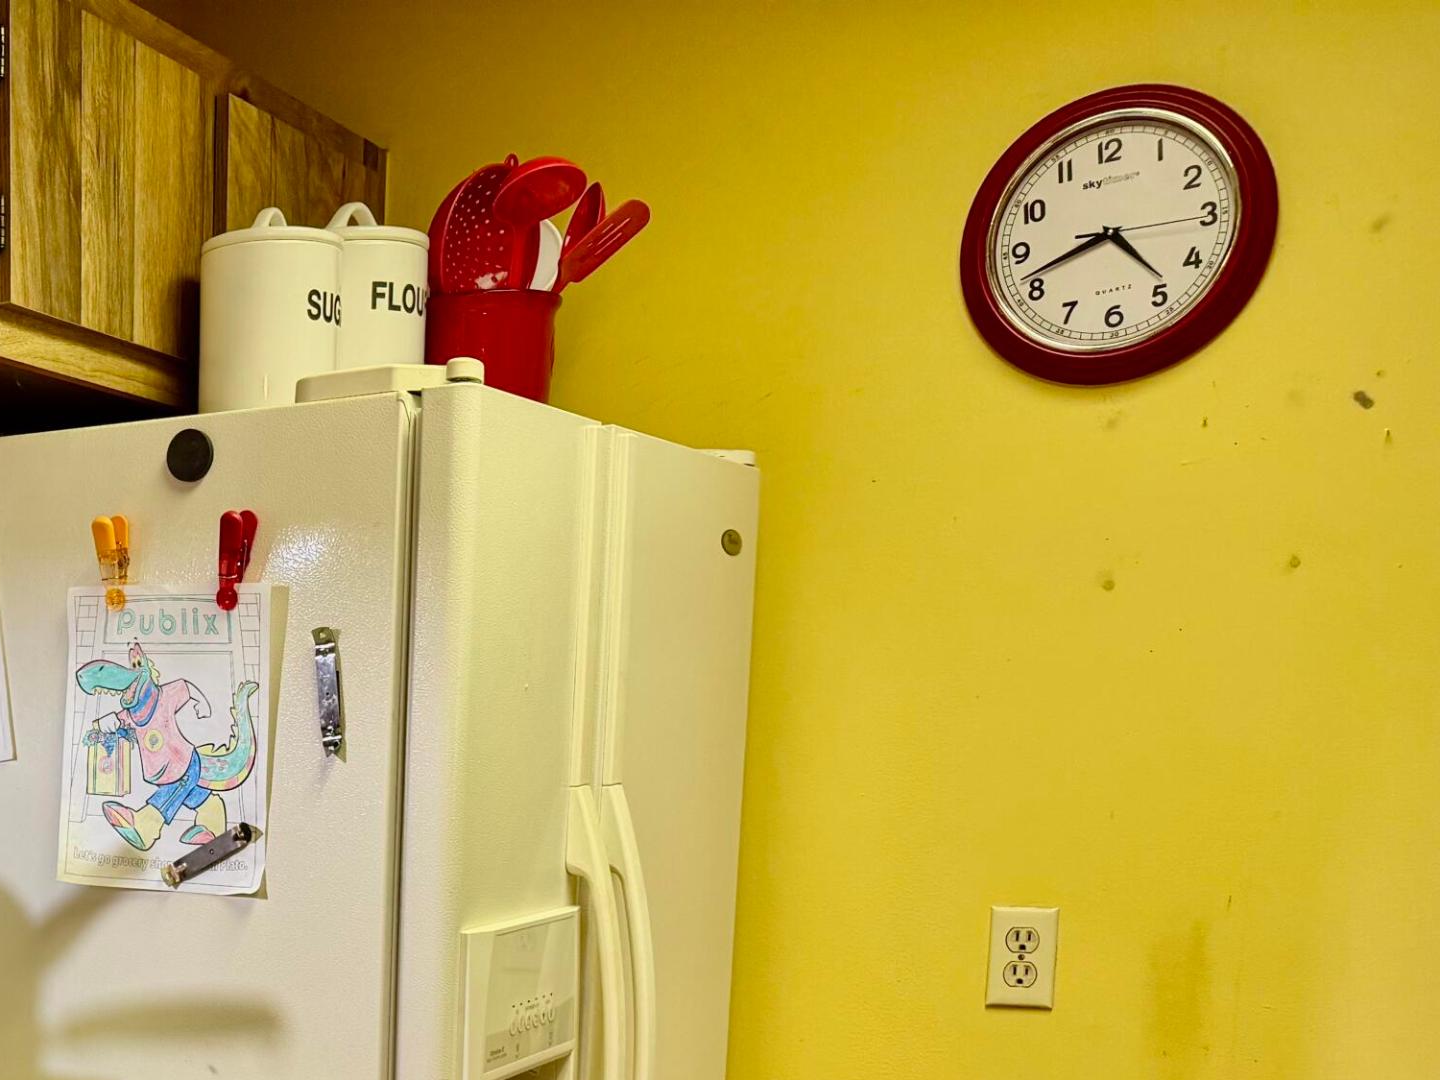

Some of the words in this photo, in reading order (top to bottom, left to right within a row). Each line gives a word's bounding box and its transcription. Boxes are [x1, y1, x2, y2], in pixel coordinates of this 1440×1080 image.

[1097, 138, 1123, 165] 12
[1157, 138, 1164, 162] 1
[1057, 158, 1073, 184] 11
[1183, 164, 1202, 190] 2
[1023, 199, 1046, 225] 10
[1200, 201, 1218, 226] 3
[1011, 241, 1031, 265] 9
[1182, 246, 1203, 269] 4
[371, 281, 428, 317] FLOU
[1028, 278, 1045, 301] 8
[1095, 283, 1132, 296] QUARTZ
[1151, 283, 1168, 307] 5
[1062, 300, 1079, 325] 7
[1104, 304, 1124, 328] 6
[117, 607, 219, 636] Publix
[98, 855, 110, 865] go
[112, 855, 147, 871] grocery
